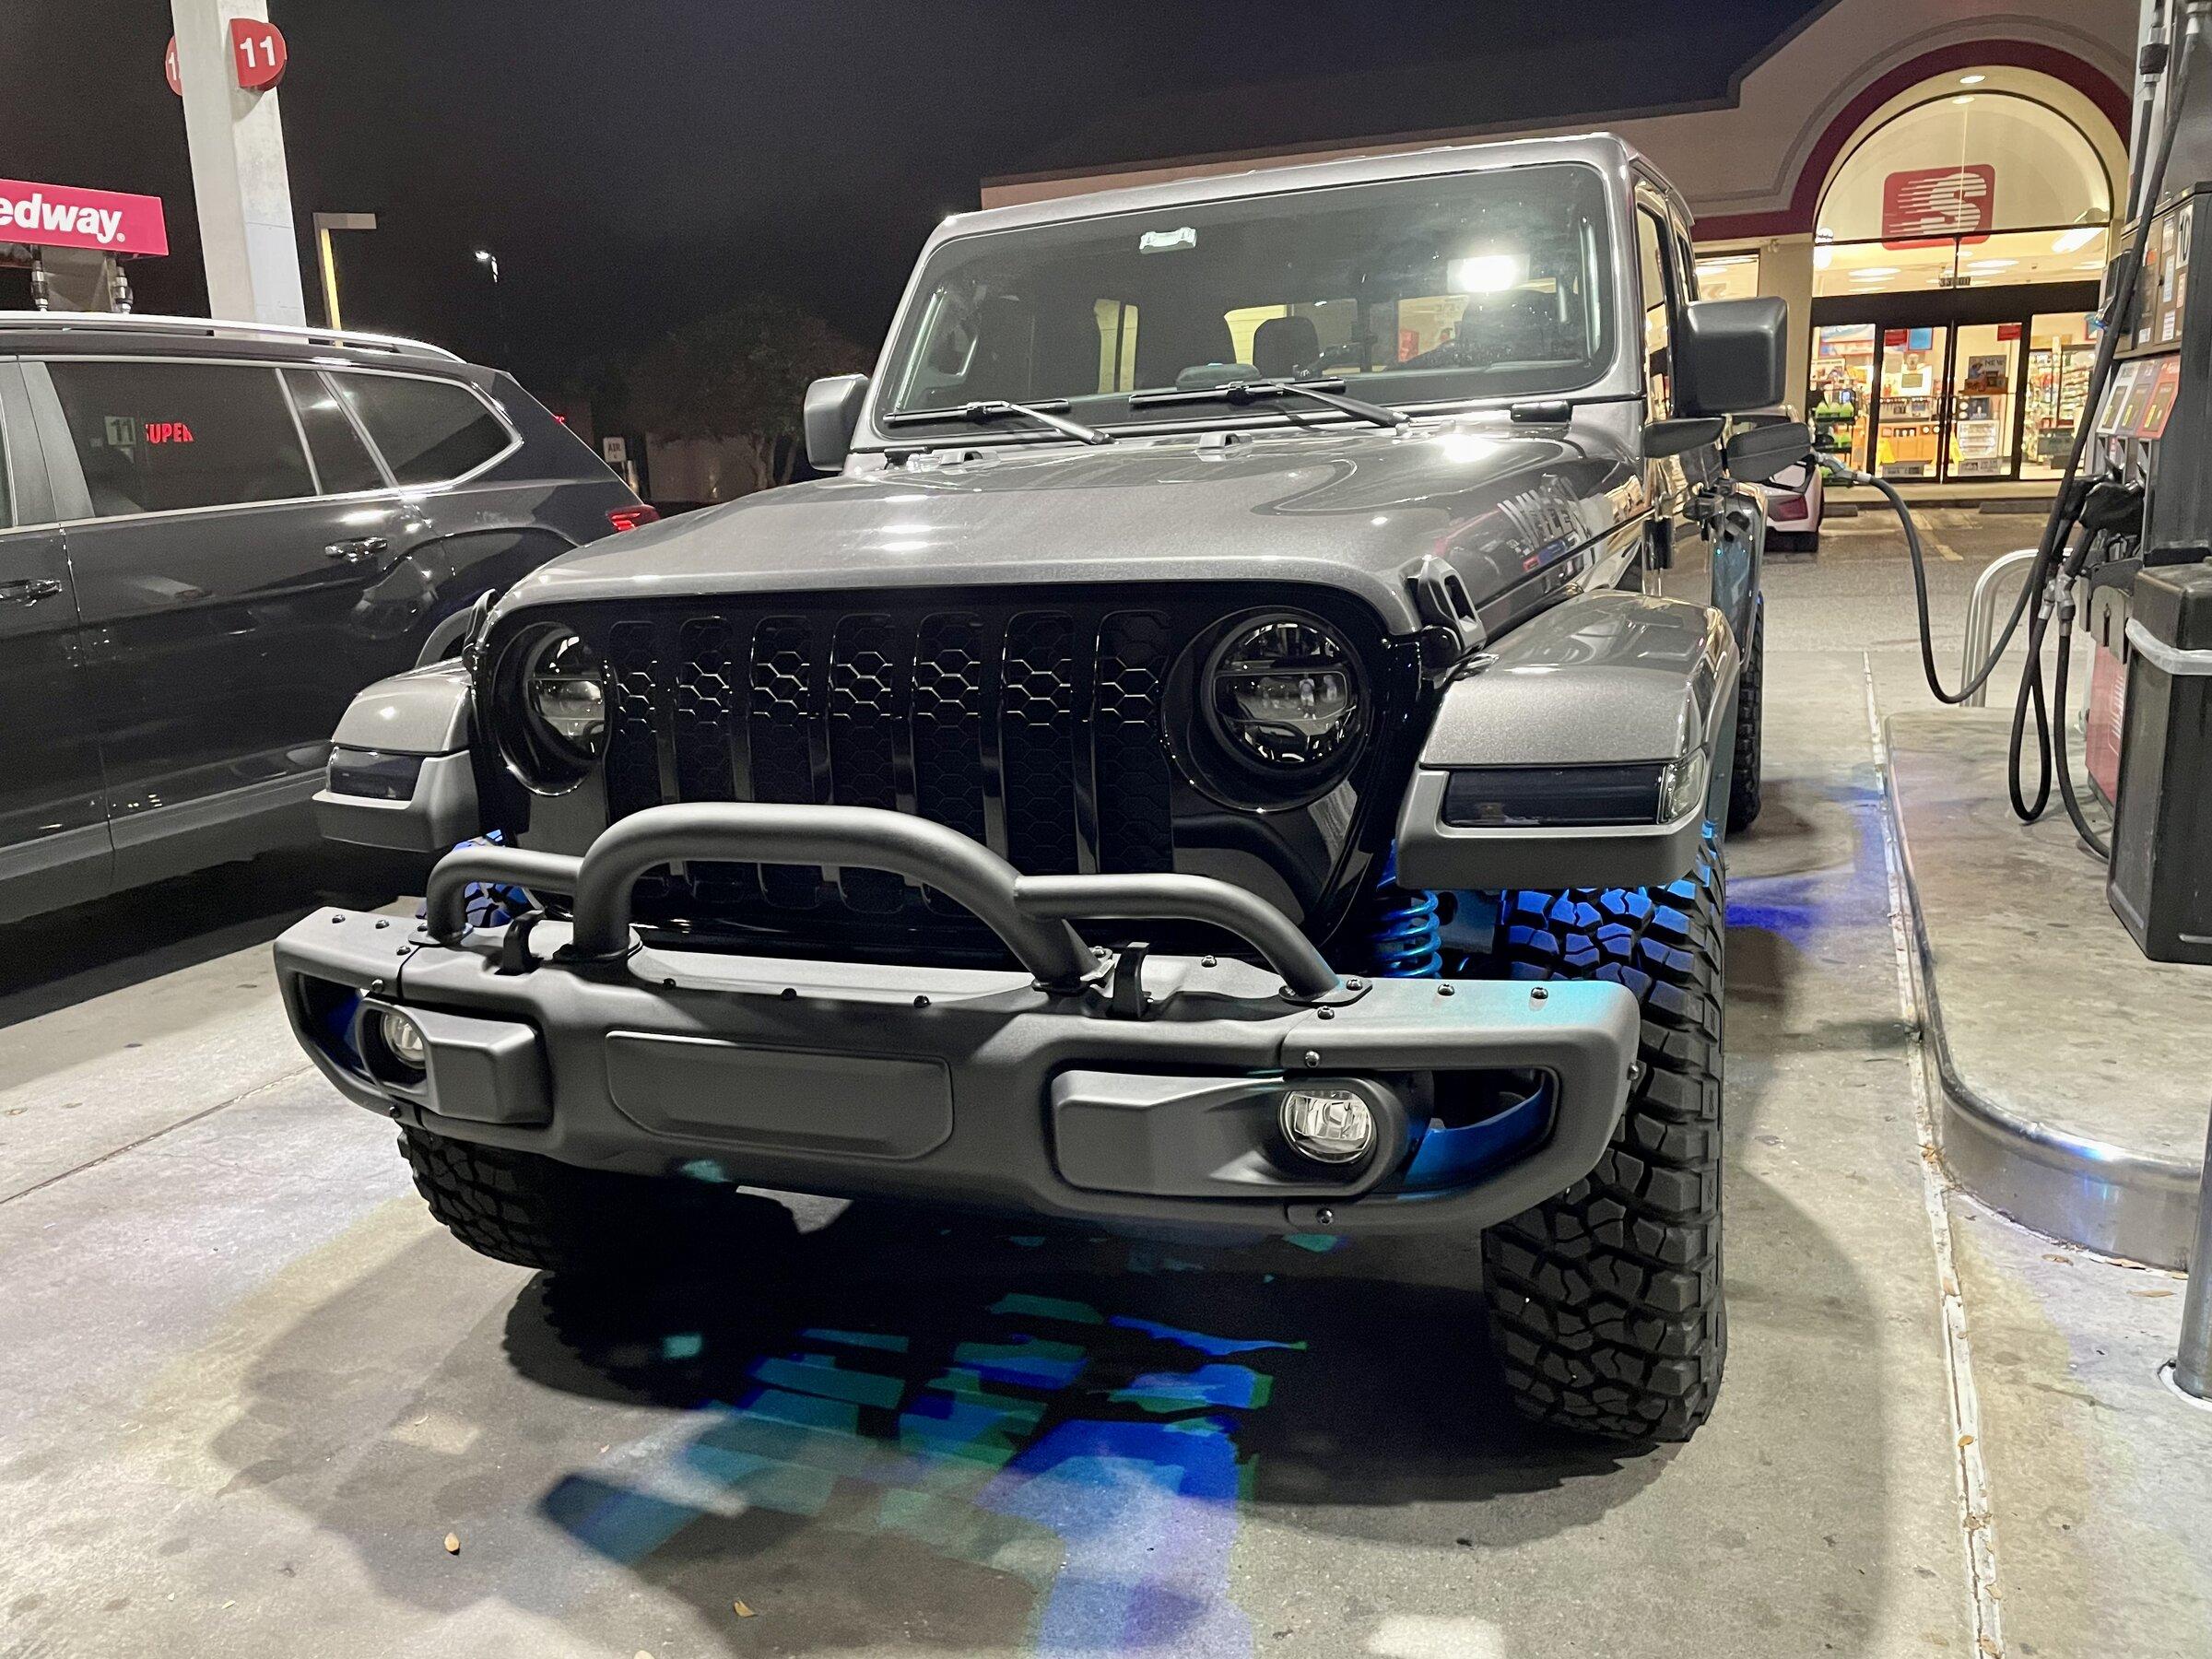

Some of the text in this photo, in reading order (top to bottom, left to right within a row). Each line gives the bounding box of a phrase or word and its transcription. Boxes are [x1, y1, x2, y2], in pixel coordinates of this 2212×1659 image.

[168, 52, 181, 80] 1
[240, 36, 276, 68] 11
[608, 443, 621, 453] AIR
